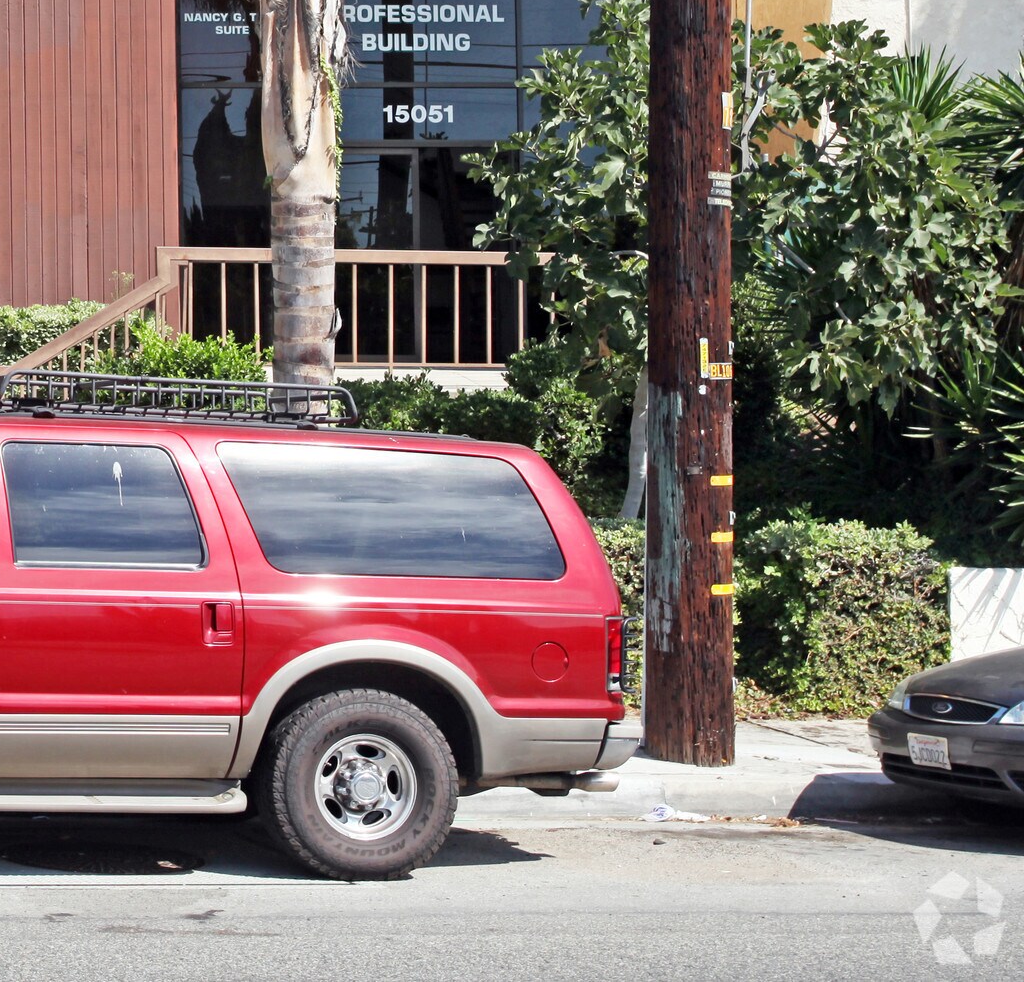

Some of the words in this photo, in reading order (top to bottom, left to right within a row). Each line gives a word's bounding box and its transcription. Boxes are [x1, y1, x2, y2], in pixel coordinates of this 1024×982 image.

[184, 13, 226, 22] NANCY
[233, 13, 245, 22] G.
[343, 5, 505, 23] ROFESSIONAL
[215, 25, 249, 35] SUITE
[362, 33, 470, 51] BUILDING
[383, 105, 454, 123] 15051
